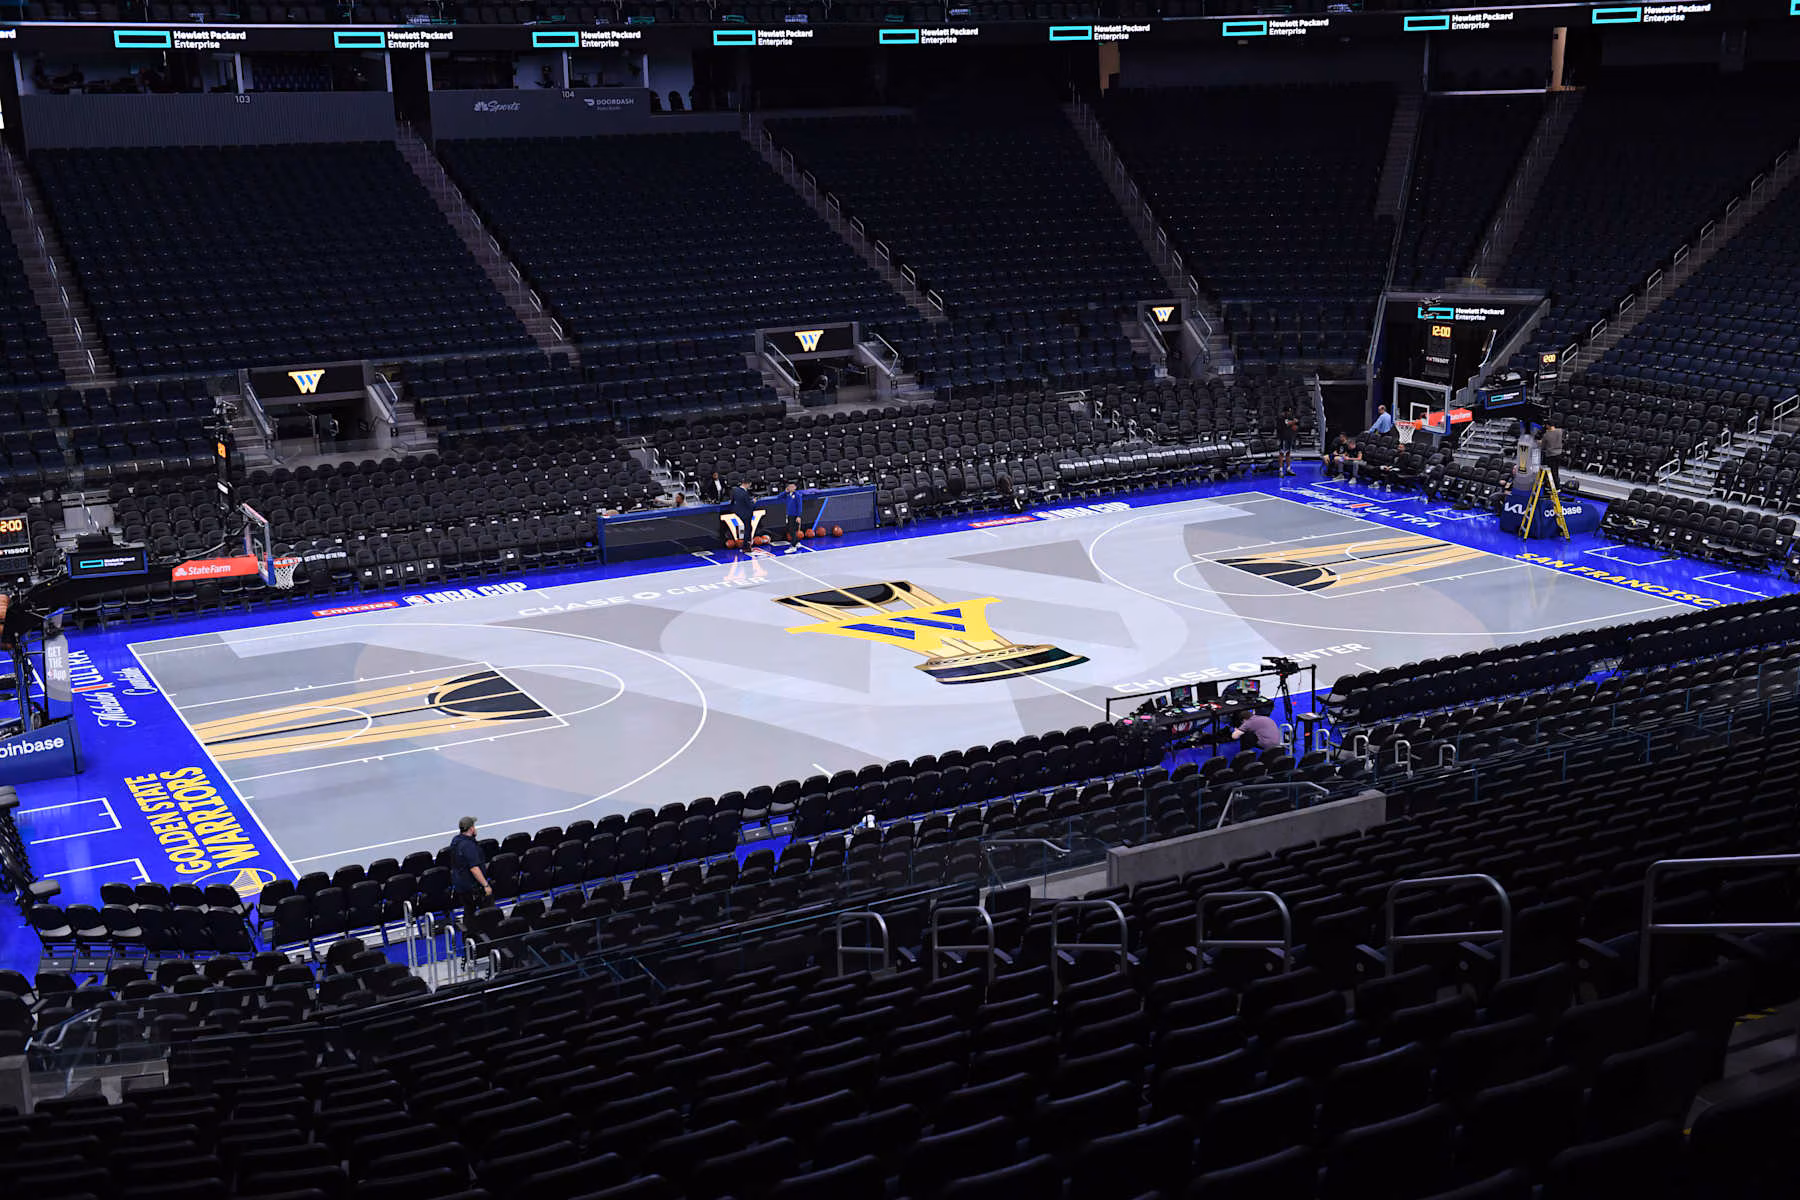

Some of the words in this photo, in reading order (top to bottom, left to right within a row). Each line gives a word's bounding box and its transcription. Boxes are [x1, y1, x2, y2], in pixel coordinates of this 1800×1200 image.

[1644, 6, 1676, 14] Hewlett
[1677, 3, 1711, 13] Packard
[1452, 14, 1482, 22] Hewlett
[1482, 12, 1513, 21] Packard
[1643, 14, 1685, 23] Enterprise
[1122, 24, 1150, 32] Packard
[1299, 19, 1329, 27] Packard
[1452, 22, 1490, 30] Enterprise
[173, 31, 209, 39] Hewlett
[210, 31, 246, 39] Packard
[581, 31, 610, 39] Hewlett
[611, 31, 641, 39] Packard
[921, 28, 949, 36] Hewlett
[950, 28, 978, 36] Packard
[1094, 32, 1129, 41] Enterprise
[1269, 28, 1306, 36] Enterprise
[174, 40, 220, 50] Enterprise
[388, 40, 429, 49] Enterprise
[581, 40, 619, 48] Enterprise
[758, 38, 792, 47] Enterprise
[921, 36, 957, 45] Enterprise
[235, 95, 250, 104] 103
[488, 100, 521, 112] Sports
[1152, 307, 1174, 322] W
[1432, 325, 1451, 338] 12:00
[795, 330, 824, 352] W
[288, 369, 325, 393] W
[1544, 505, 1582, 517] cobase
[1365, 506, 1440, 528] ULTRA
[0, 519, 23, 533] 2:00
[4, 547, 29, 555] TISSOT
[1516, 553, 1575, 569] SAN
[1569, 566, 1727, 607] FRANCISC
[423, 588, 477, 607] NBA
[477, 581, 528, 597] CUP
[518, 595, 631, 617] CHASE
[662, 577, 771, 595] CENTER
[319, 601, 394, 616] Emirates
[47, 646, 61, 658] GET
[49, 658, 63, 668] THE
[1113, 667, 1231, 694] CHASE
[0, 737, 65, 758] oinbase
[123, 773, 175, 812] STATE
[160, 766, 260, 869] WARRIORS
[146, 811, 213, 875] GOLDEN
